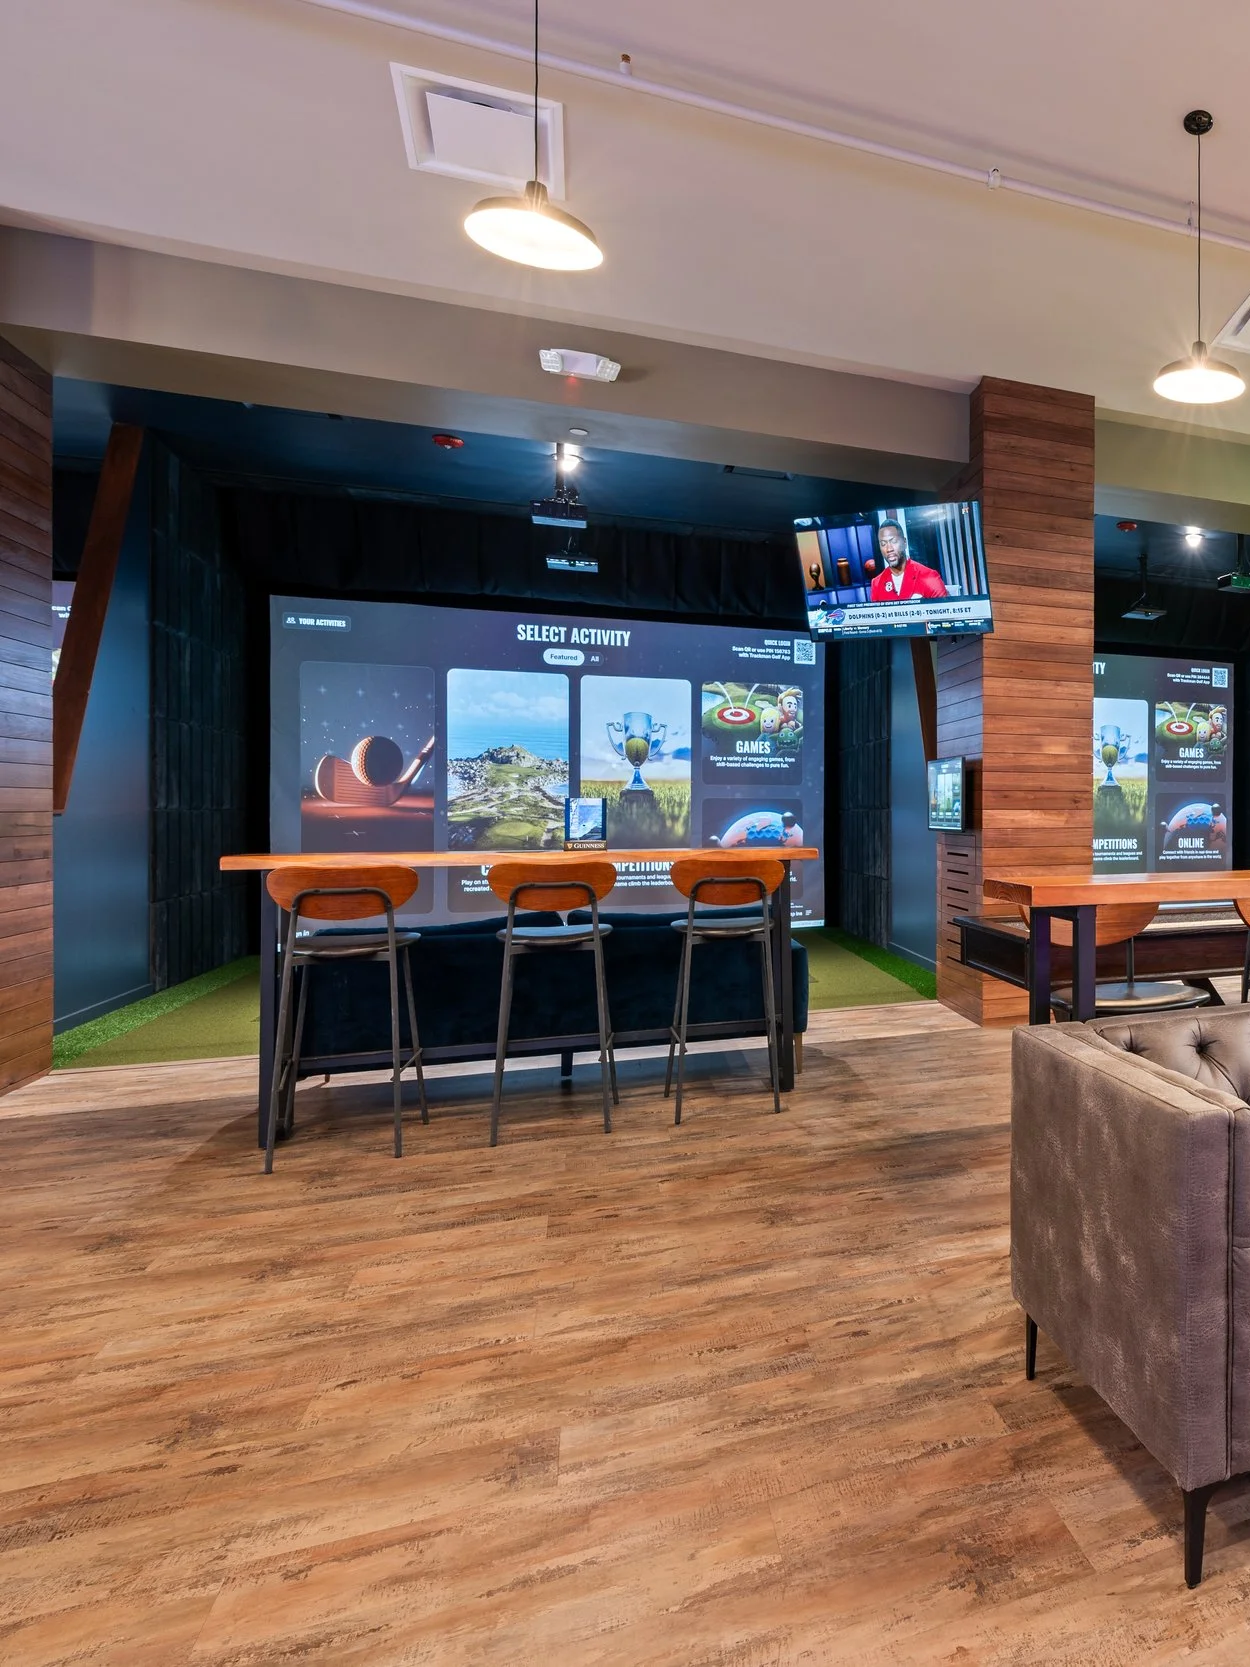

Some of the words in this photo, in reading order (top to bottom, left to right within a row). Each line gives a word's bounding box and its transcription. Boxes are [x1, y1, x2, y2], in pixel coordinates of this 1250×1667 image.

[848, 612, 874, 620] DOLPHINS
[299, 617, 315, 626] YOUR
[316, 619, 346, 628] ACTIVITIES
[517, 623, 567, 643] SELECT
[570, 627, 631, 647] ACTIVITY
[550, 653, 578, 661] Featured
[736, 740, 771, 754] GAMES
[1179, 747, 1204, 758] GAMES
[1093, 838, 1138, 850] MPETITIONS
[1178, 837, 1205, 849] ONLINE
[612, 861, 675, 872] MPETITION
